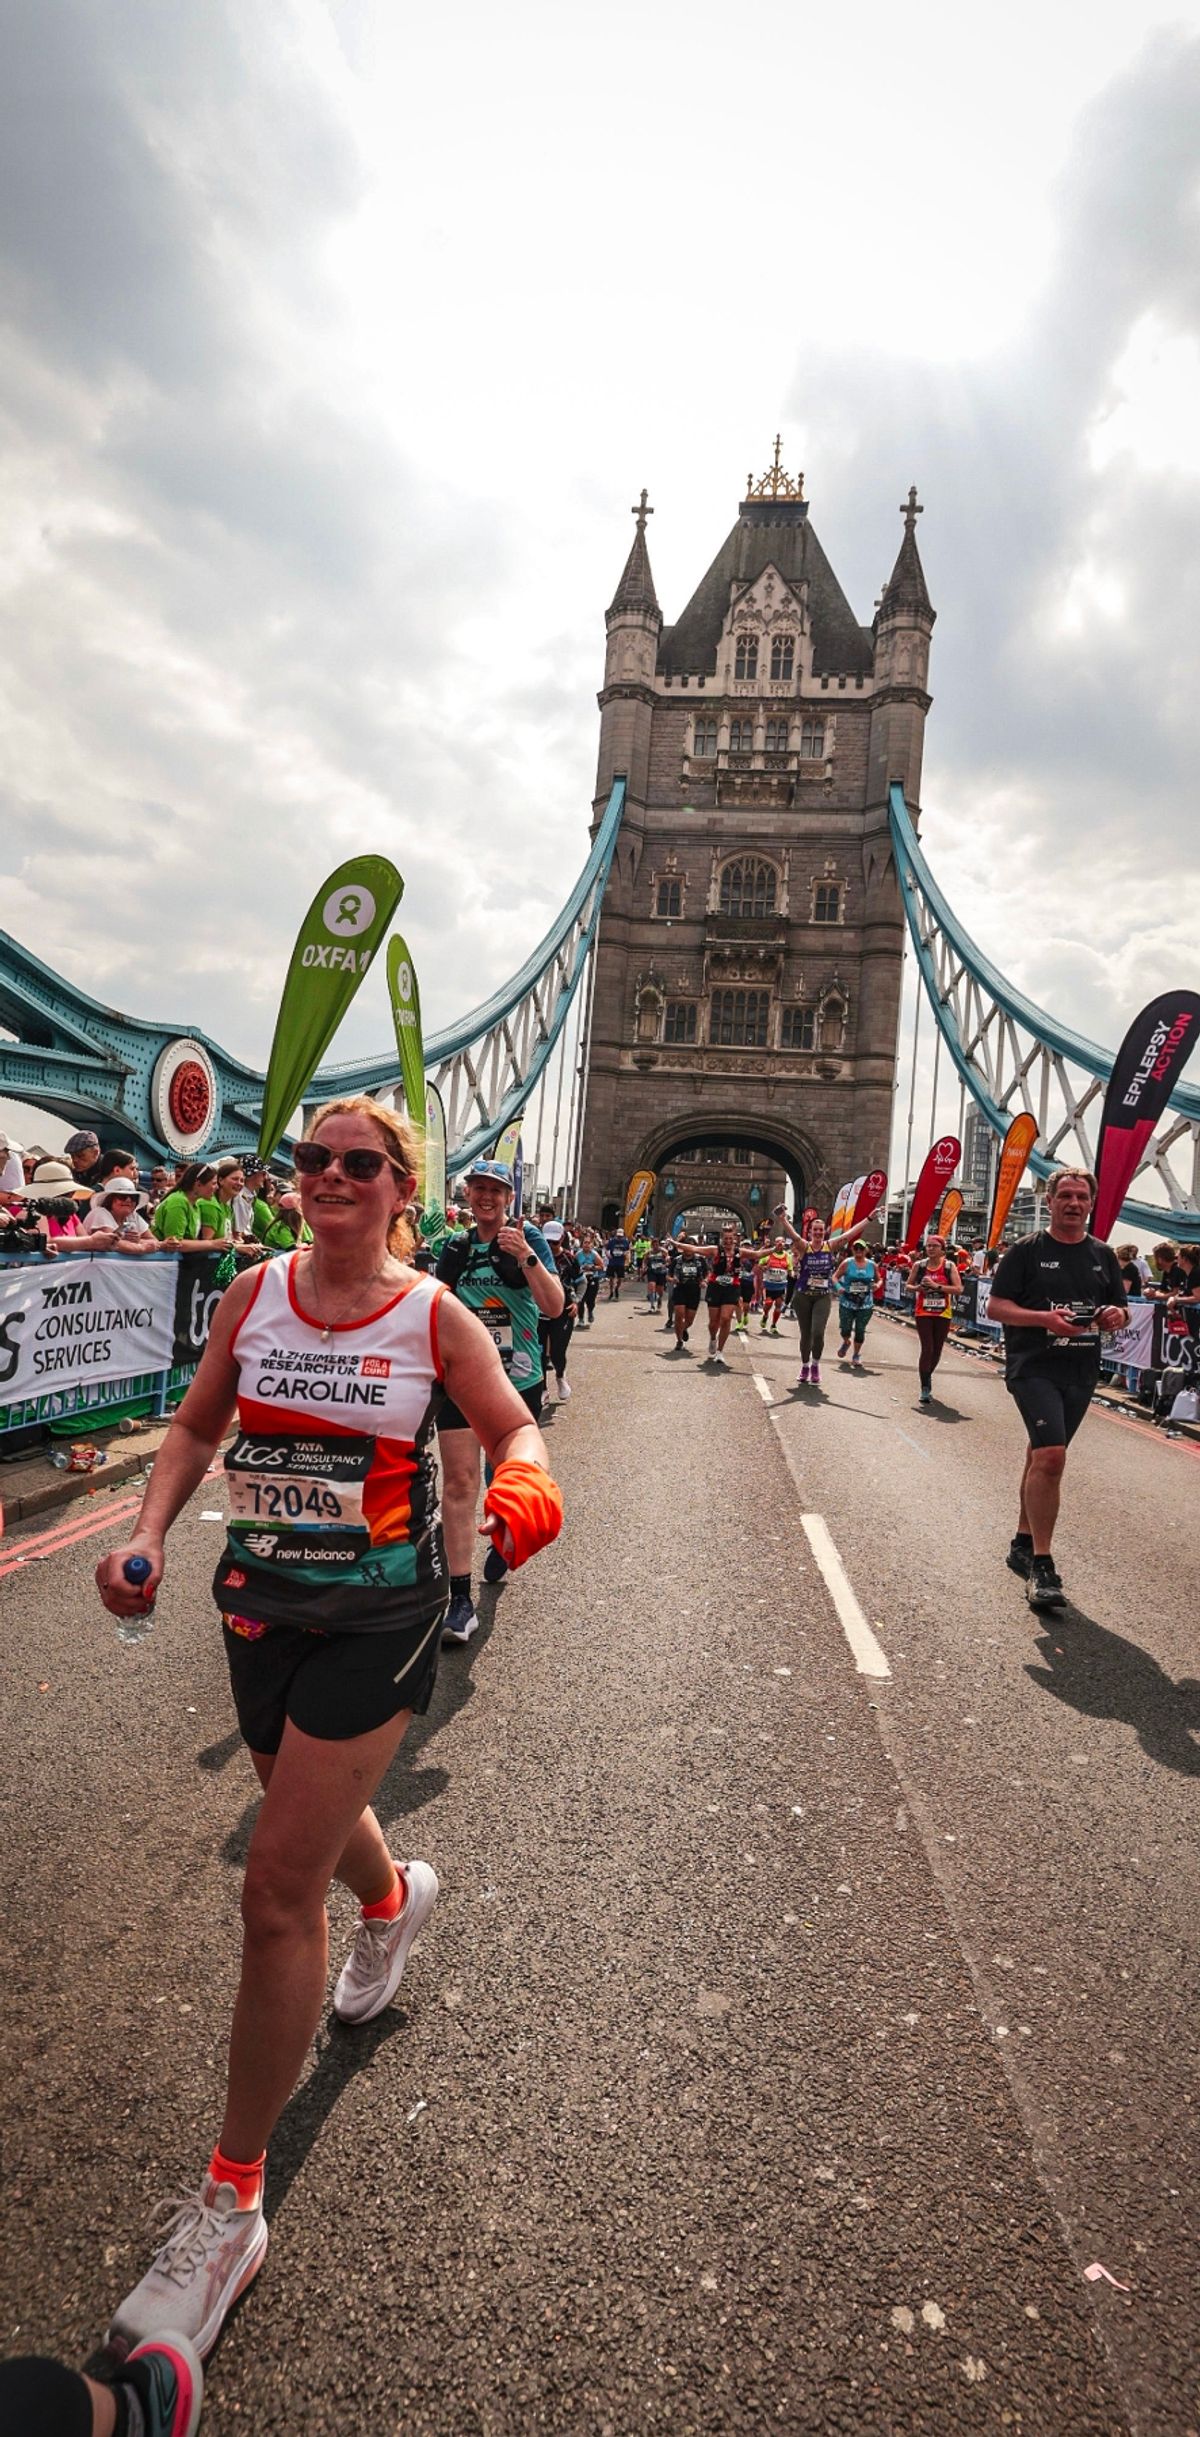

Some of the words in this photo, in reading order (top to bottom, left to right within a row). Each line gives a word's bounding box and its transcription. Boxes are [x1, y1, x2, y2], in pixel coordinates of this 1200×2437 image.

[1151, 1012, 1193, 1081] ACTION
[1122, 1020, 1171, 1107] EPILEPSY
[41, 1281, 93, 1309] TATA
[34, 1308, 153, 1341] CONSULTANCY
[33, 1339, 111, 1374] SERVICES
[260, 1358, 335, 1375] RESEARCH
[337, 1366, 358, 1376] UK
[268, 1348, 361, 1366] ALZHEIMER'S
[365, 1358, 380, 1368] FOR
[381, 1361, 388, 1369] A
[364, 1366, 388, 1376] CURE
[256, 1375, 387, 1406] CAROLINE
[234, 1440, 288, 1466] tcs
[291, 1452, 364, 1466] CONSULTANCY
[293, 1442, 324, 1452] TATA
[286, 1463, 334, 1472] SERVICES
[246, 1483, 342, 1518] 72049
[276, 1550, 302, 1560] new
[304, 1548, 356, 1561] balance
[430, 1556, 443, 1580] UK
